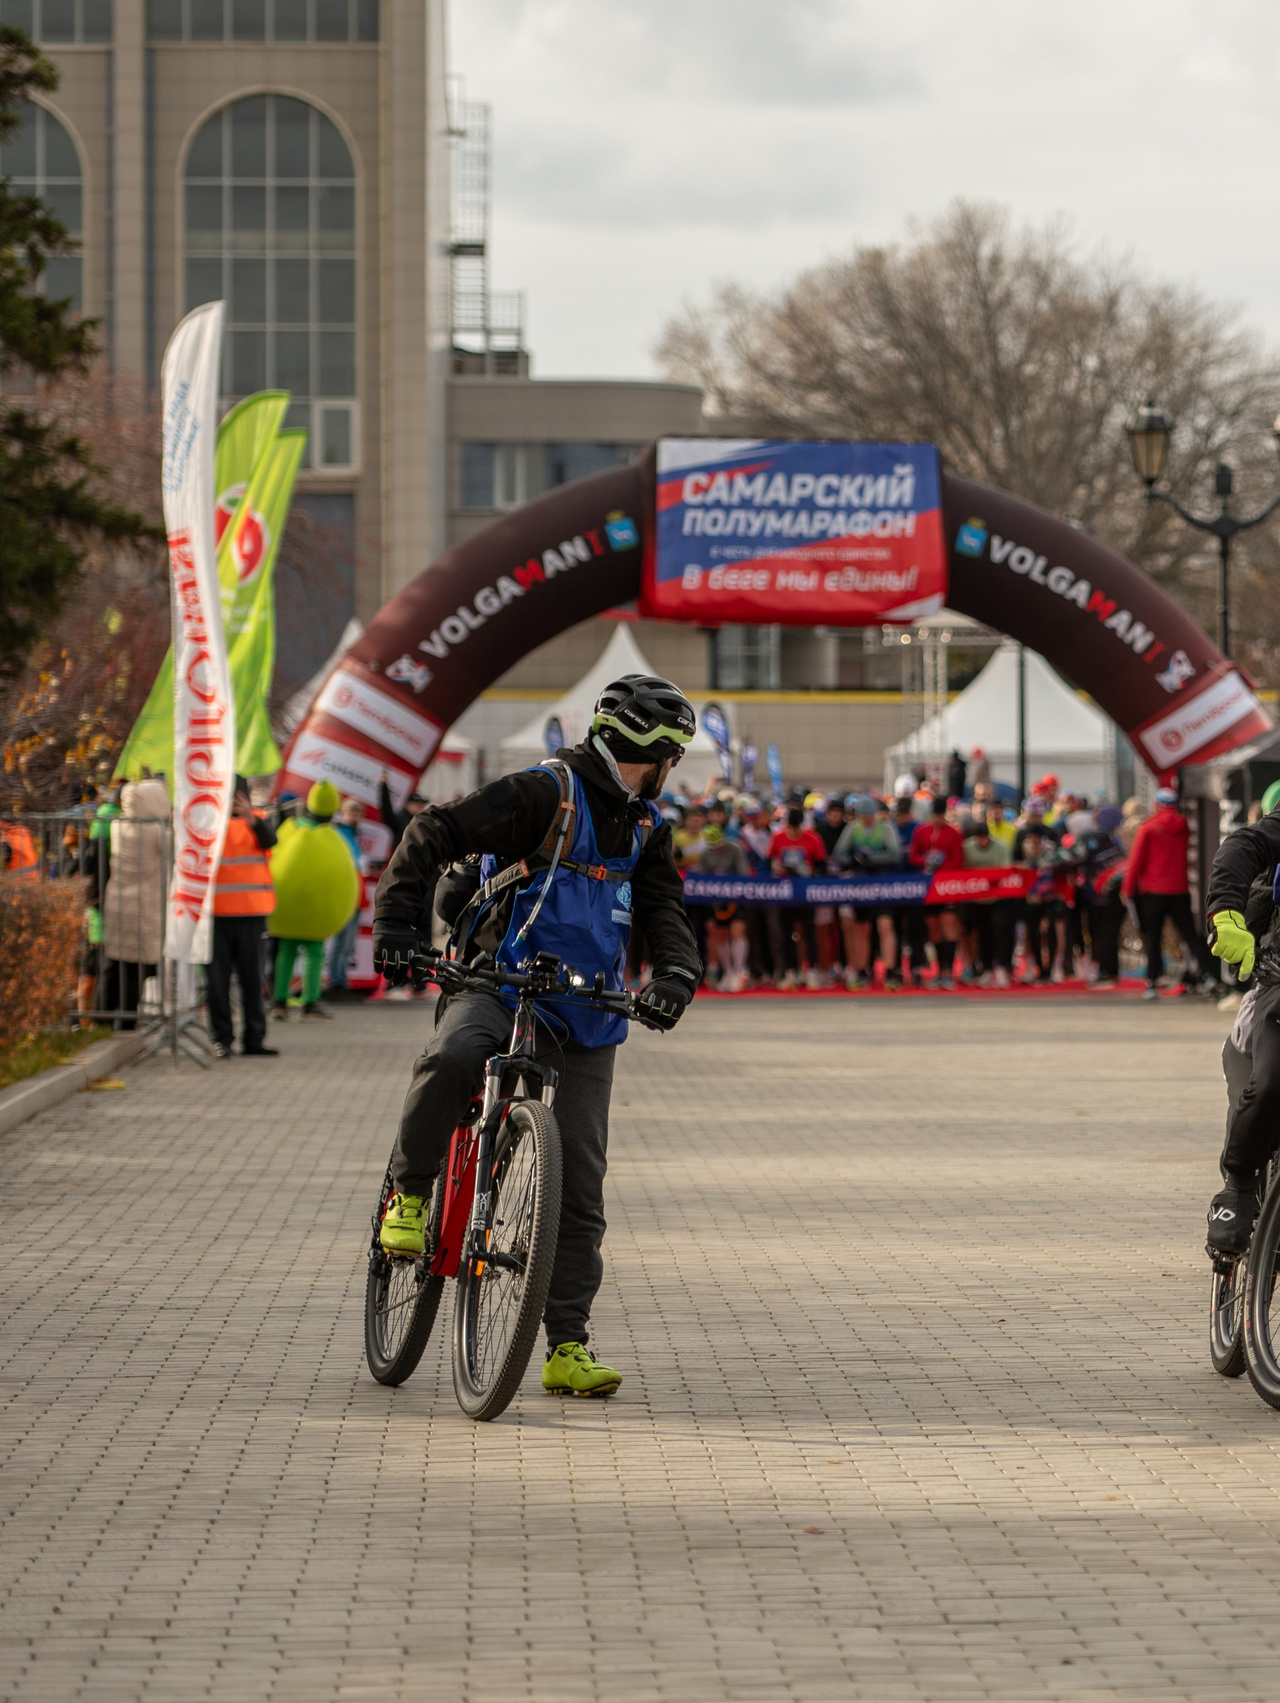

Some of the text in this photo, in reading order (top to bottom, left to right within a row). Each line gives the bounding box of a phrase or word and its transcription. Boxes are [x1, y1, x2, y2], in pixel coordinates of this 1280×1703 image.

[682, 464, 916, 507] САМАРСКИЙ
[682, 509, 916, 538] ПОЛУМАРАФОН
[682, 564, 703, 590] В
[775, 569, 819, 591] мы
[824, 565, 919, 592] едины!
[806, 880, 927, 902] ПОЛУМАРАФОН
